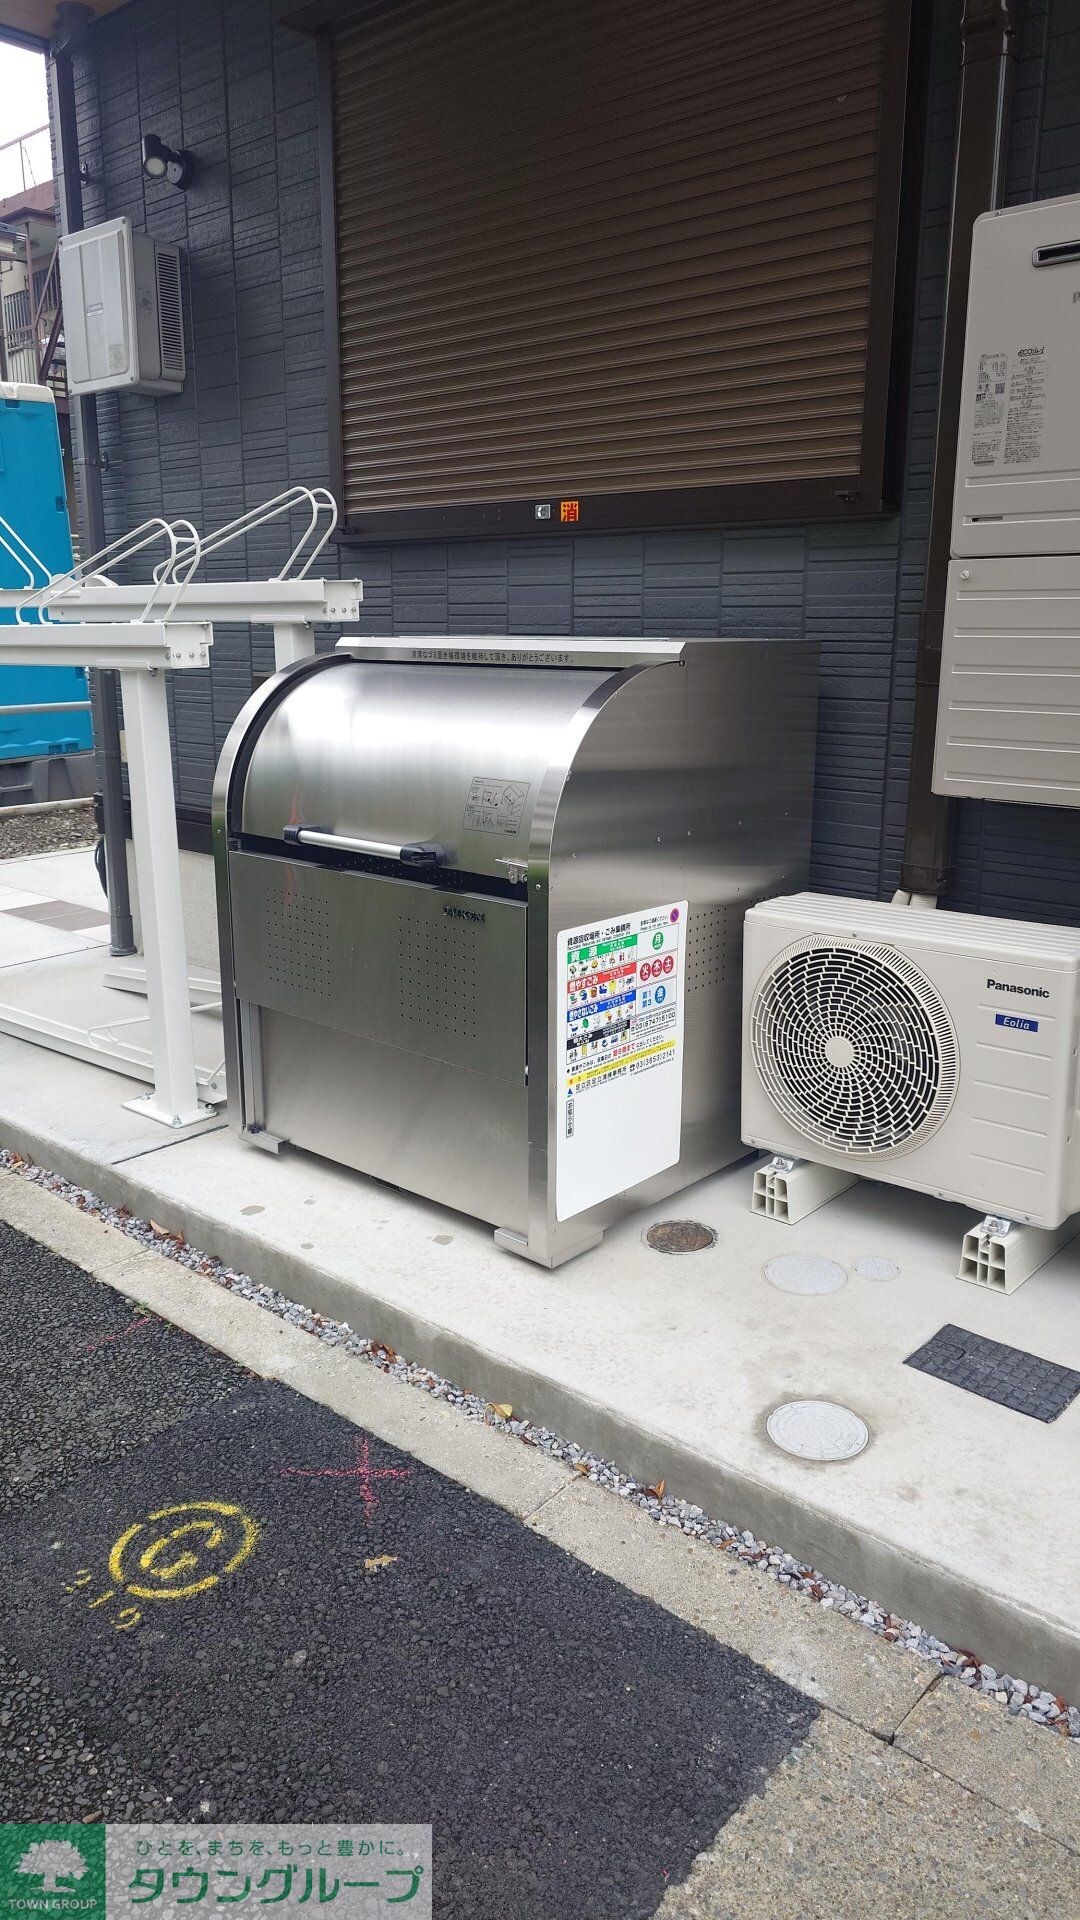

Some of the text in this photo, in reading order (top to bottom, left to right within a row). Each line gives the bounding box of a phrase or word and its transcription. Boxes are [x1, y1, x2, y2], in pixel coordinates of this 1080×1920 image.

[562, 502, 578, 521] 消
[569, 975, 598, 991] 燃やすごみ
[987, 979, 1050, 998] Panasonic
[1003, 1016, 1030, 1030] Eolia
